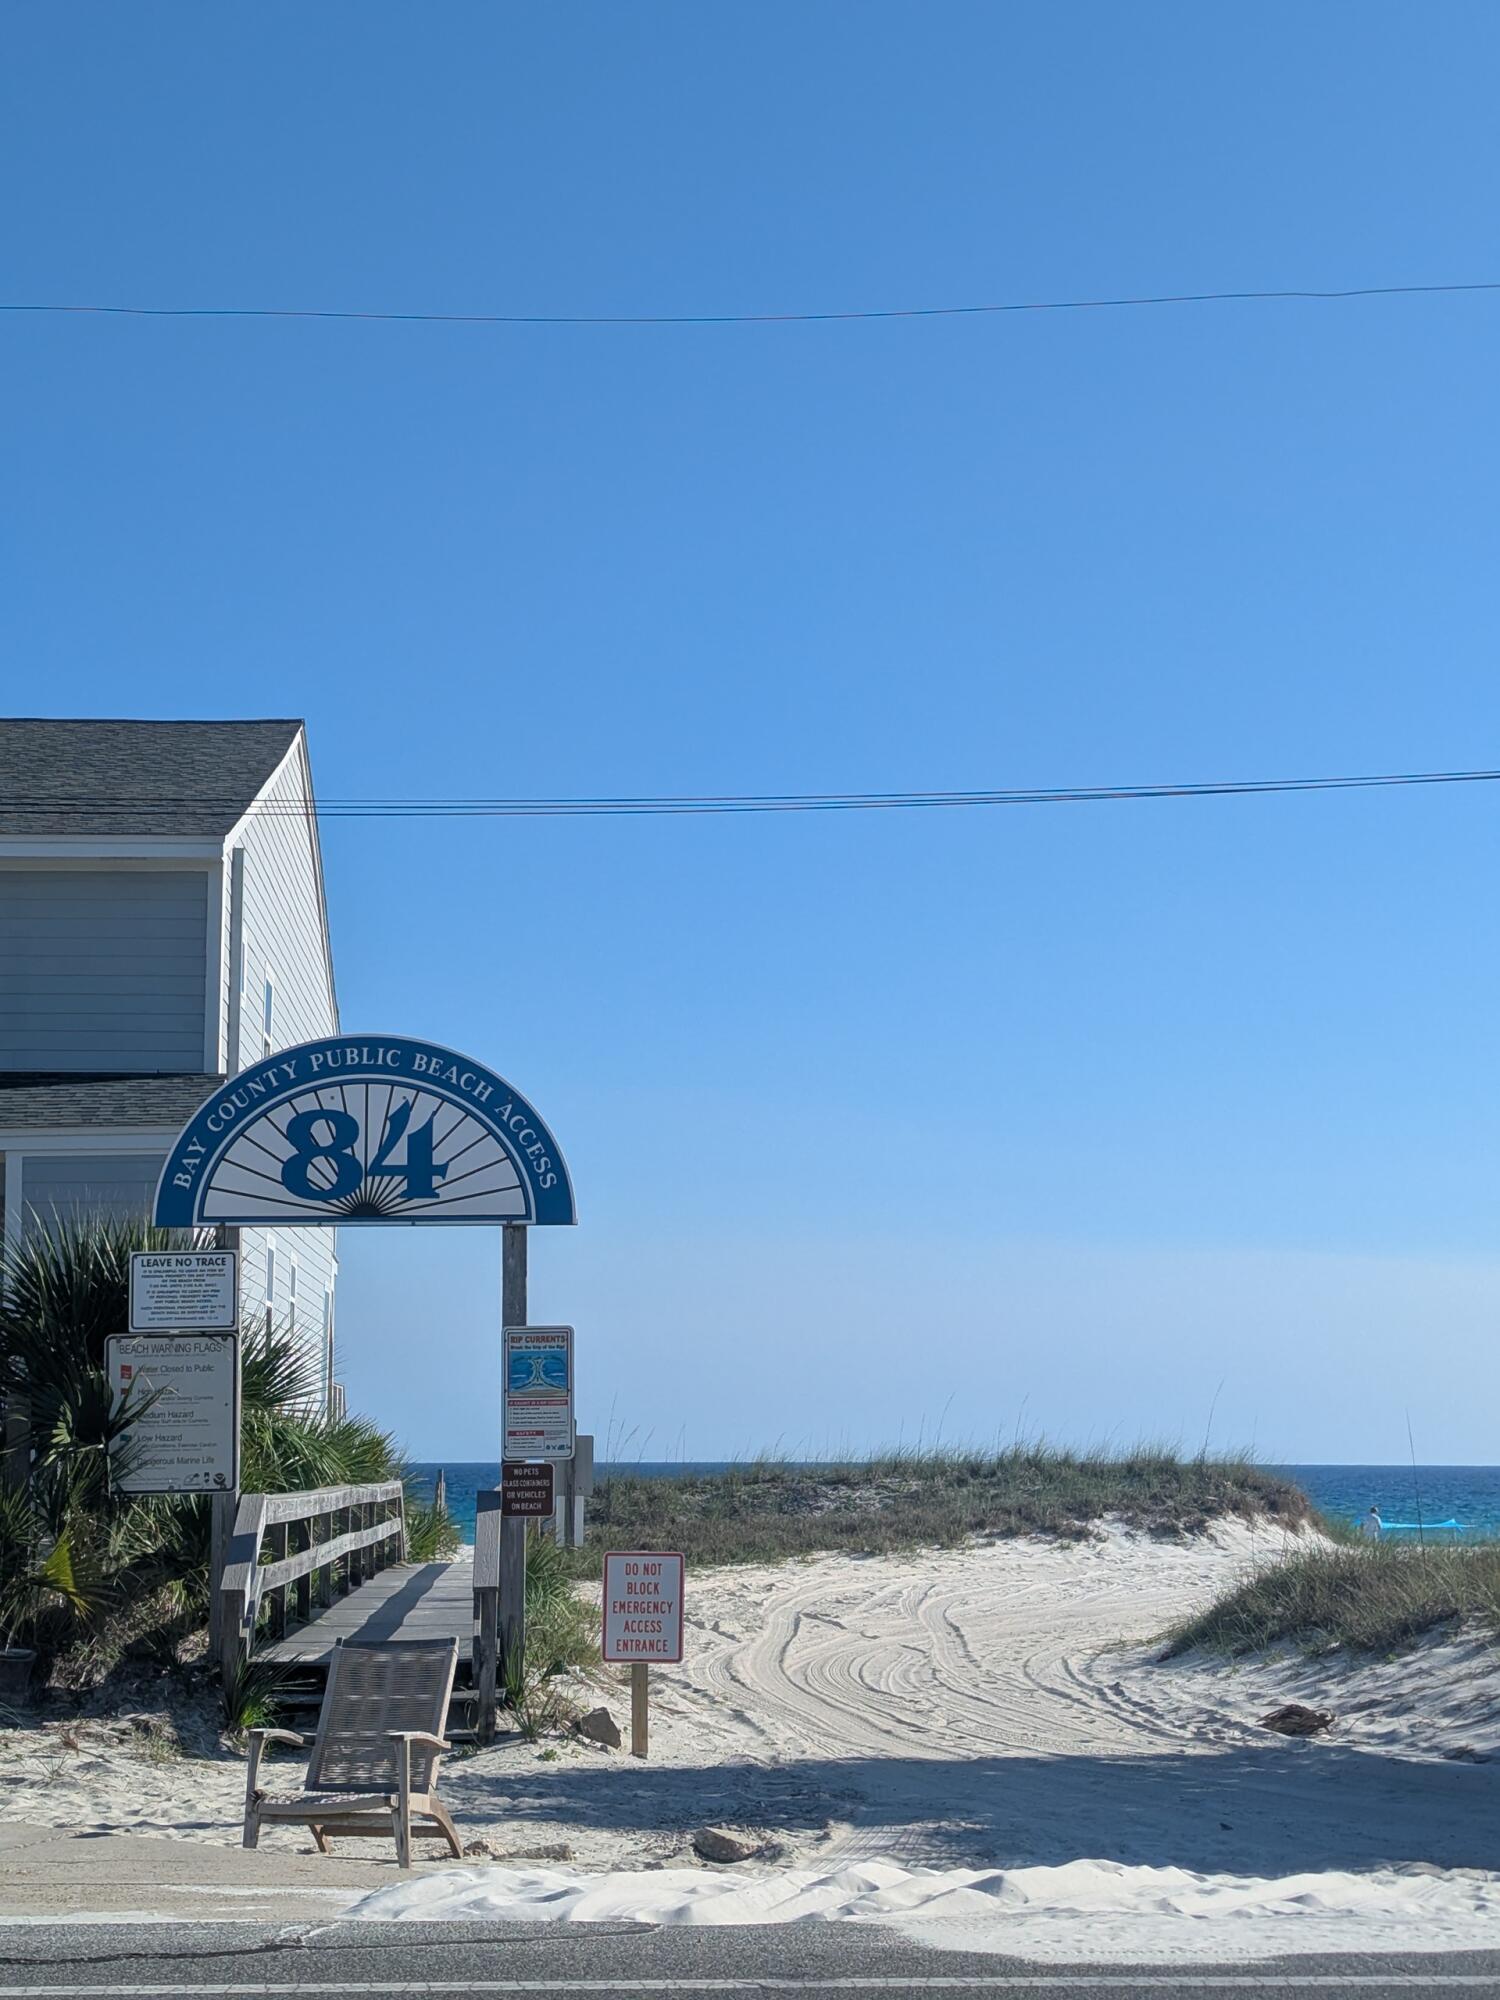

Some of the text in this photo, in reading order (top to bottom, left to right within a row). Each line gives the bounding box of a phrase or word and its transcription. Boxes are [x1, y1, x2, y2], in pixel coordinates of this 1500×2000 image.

[173, 1047, 558, 1191] BAY COUNTY PUBLIC BEACH ACCESS
[281, 1100, 450, 1201] 84
[141, 1257, 226, 1267] LEAVE NO TRACE
[510, 1335, 566, 1344] RIP CURRENTS
[119, 1342, 222, 1354] BEACH WARNING FLAGS
[160, 1365, 184, 1373] Closed
[185, 1365, 193, 1373] to
[194, 1363, 214, 1372] Public
[168, 1410, 194, 1418] Hazard
[155, 1433, 182, 1442] Hazard
[176, 1457, 201, 1465] Marine
[202, 1456, 214, 1465] Life
[513, 1468, 539, 1476] NO PETS
[506, 1491, 546, 1499] OR VEHICLES
[511, 1502, 542, 1510] ON BEACH
[625, 1563, 662, 1576] DO NOT
[627, 1582, 660, 1595] BLOCK
[612, 1600, 673, 1614] EMERGENCY
[623, 1620, 662, 1633] ACCESS
[616, 1639, 669, 1652] ENTRANCE
